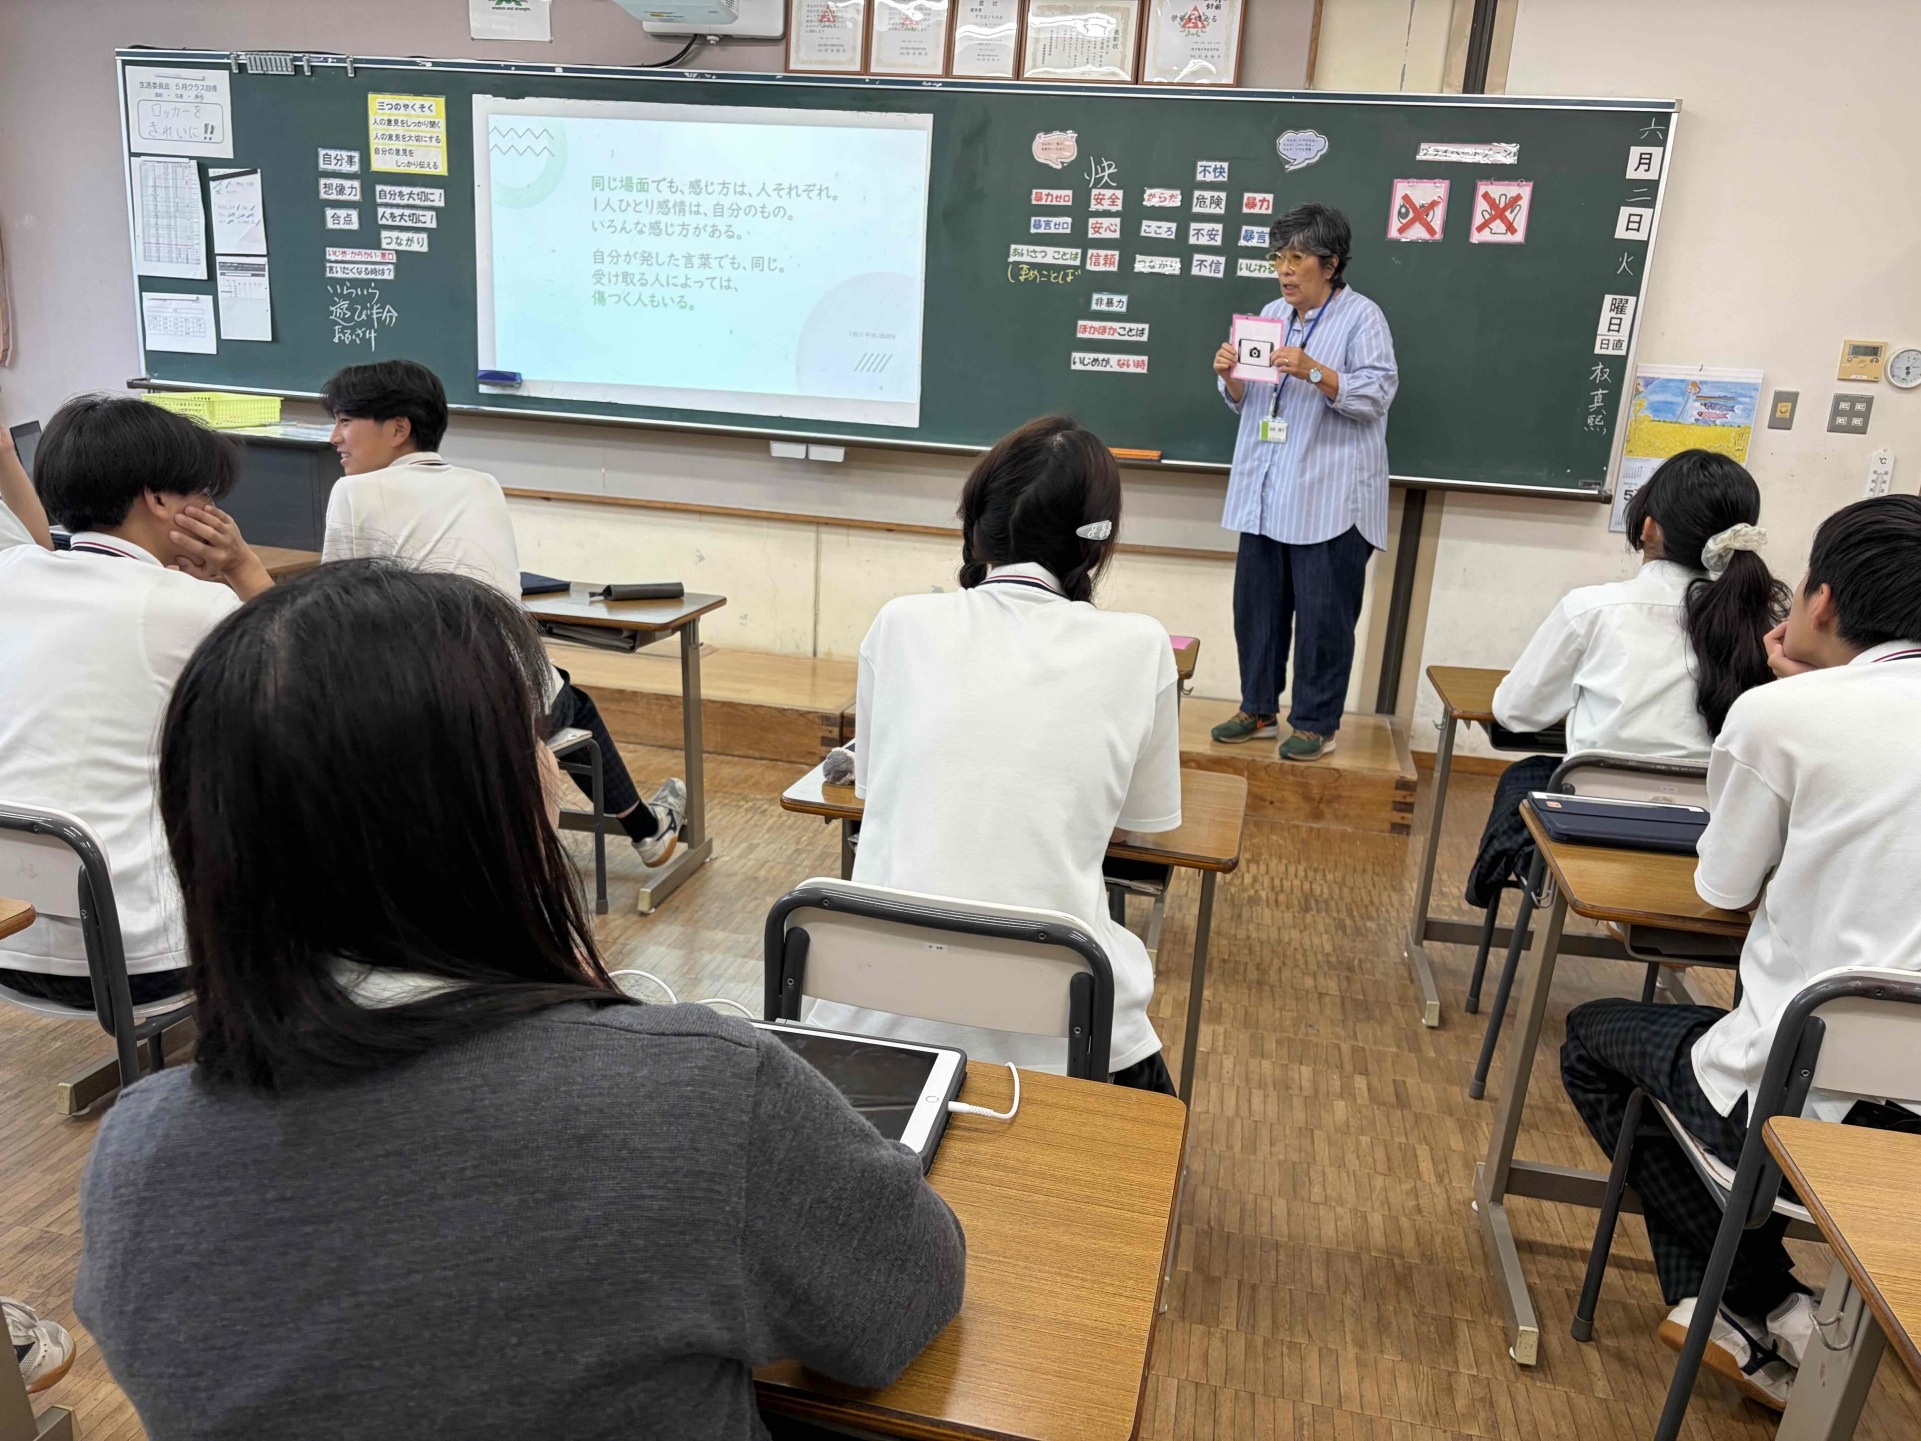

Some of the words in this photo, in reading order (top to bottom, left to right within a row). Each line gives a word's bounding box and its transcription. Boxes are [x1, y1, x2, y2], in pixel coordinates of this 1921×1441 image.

[139, 82, 170, 90] 生活委員会
[151, 103, 201, 119] ロッカーを
[377, 101, 434, 113] 三つのやくそく
[372, 118, 441, 129] 人の意見をしっかり聞く
[373, 133, 442, 144] 人の意見を大切にする
[322, 152, 358, 168] 自分事
[374, 147, 415, 158] 自分の意見を
[395, 159, 439, 170] しっかり伝える
[1084, 156, 1118, 188] 快
[1198, 164, 1227, 179] 不快
[322, 181, 359, 197] 想像力
[591, 174, 839, 202] 同じ場面でも、感じ方は、人それぞれ。
[1033, 191, 1071, 203] 暴力ゼロ
[1092, 191, 1120, 207] 安全
[1194, 194, 1224, 210] 危険
[1244, 196, 1270, 211] 暴力
[330, 212, 354, 226] 合点
[1032, 218, 1070, 231] 暴言ゼロ
[591, 218, 743, 240] いろんな感じ方がある。
[1090, 220, 1118, 235] 安心
[1143, 224, 1174, 237] こころ
[1191, 227, 1220, 243] 不安
[383, 235, 425, 247] つながり
[1242, 229, 1269, 244] 暴言
[592, 248, 785, 274] 自分が発した言葉でも、同じ。
[1089, 252, 1117, 268] 信頼
[1194, 259, 1223, 274] 不信
[1239, 262, 1277, 274] いじわる
[591, 269, 739, 292] 受け取る人によっては、
[327, 281, 379, 305] いらいら
[592, 289, 696, 312] 傷つく人もいる。
[1094, 297, 1125, 309] 非暴力
[329, 297, 399, 330] 遊び半分
[1599, 338, 1625, 351] 日直
